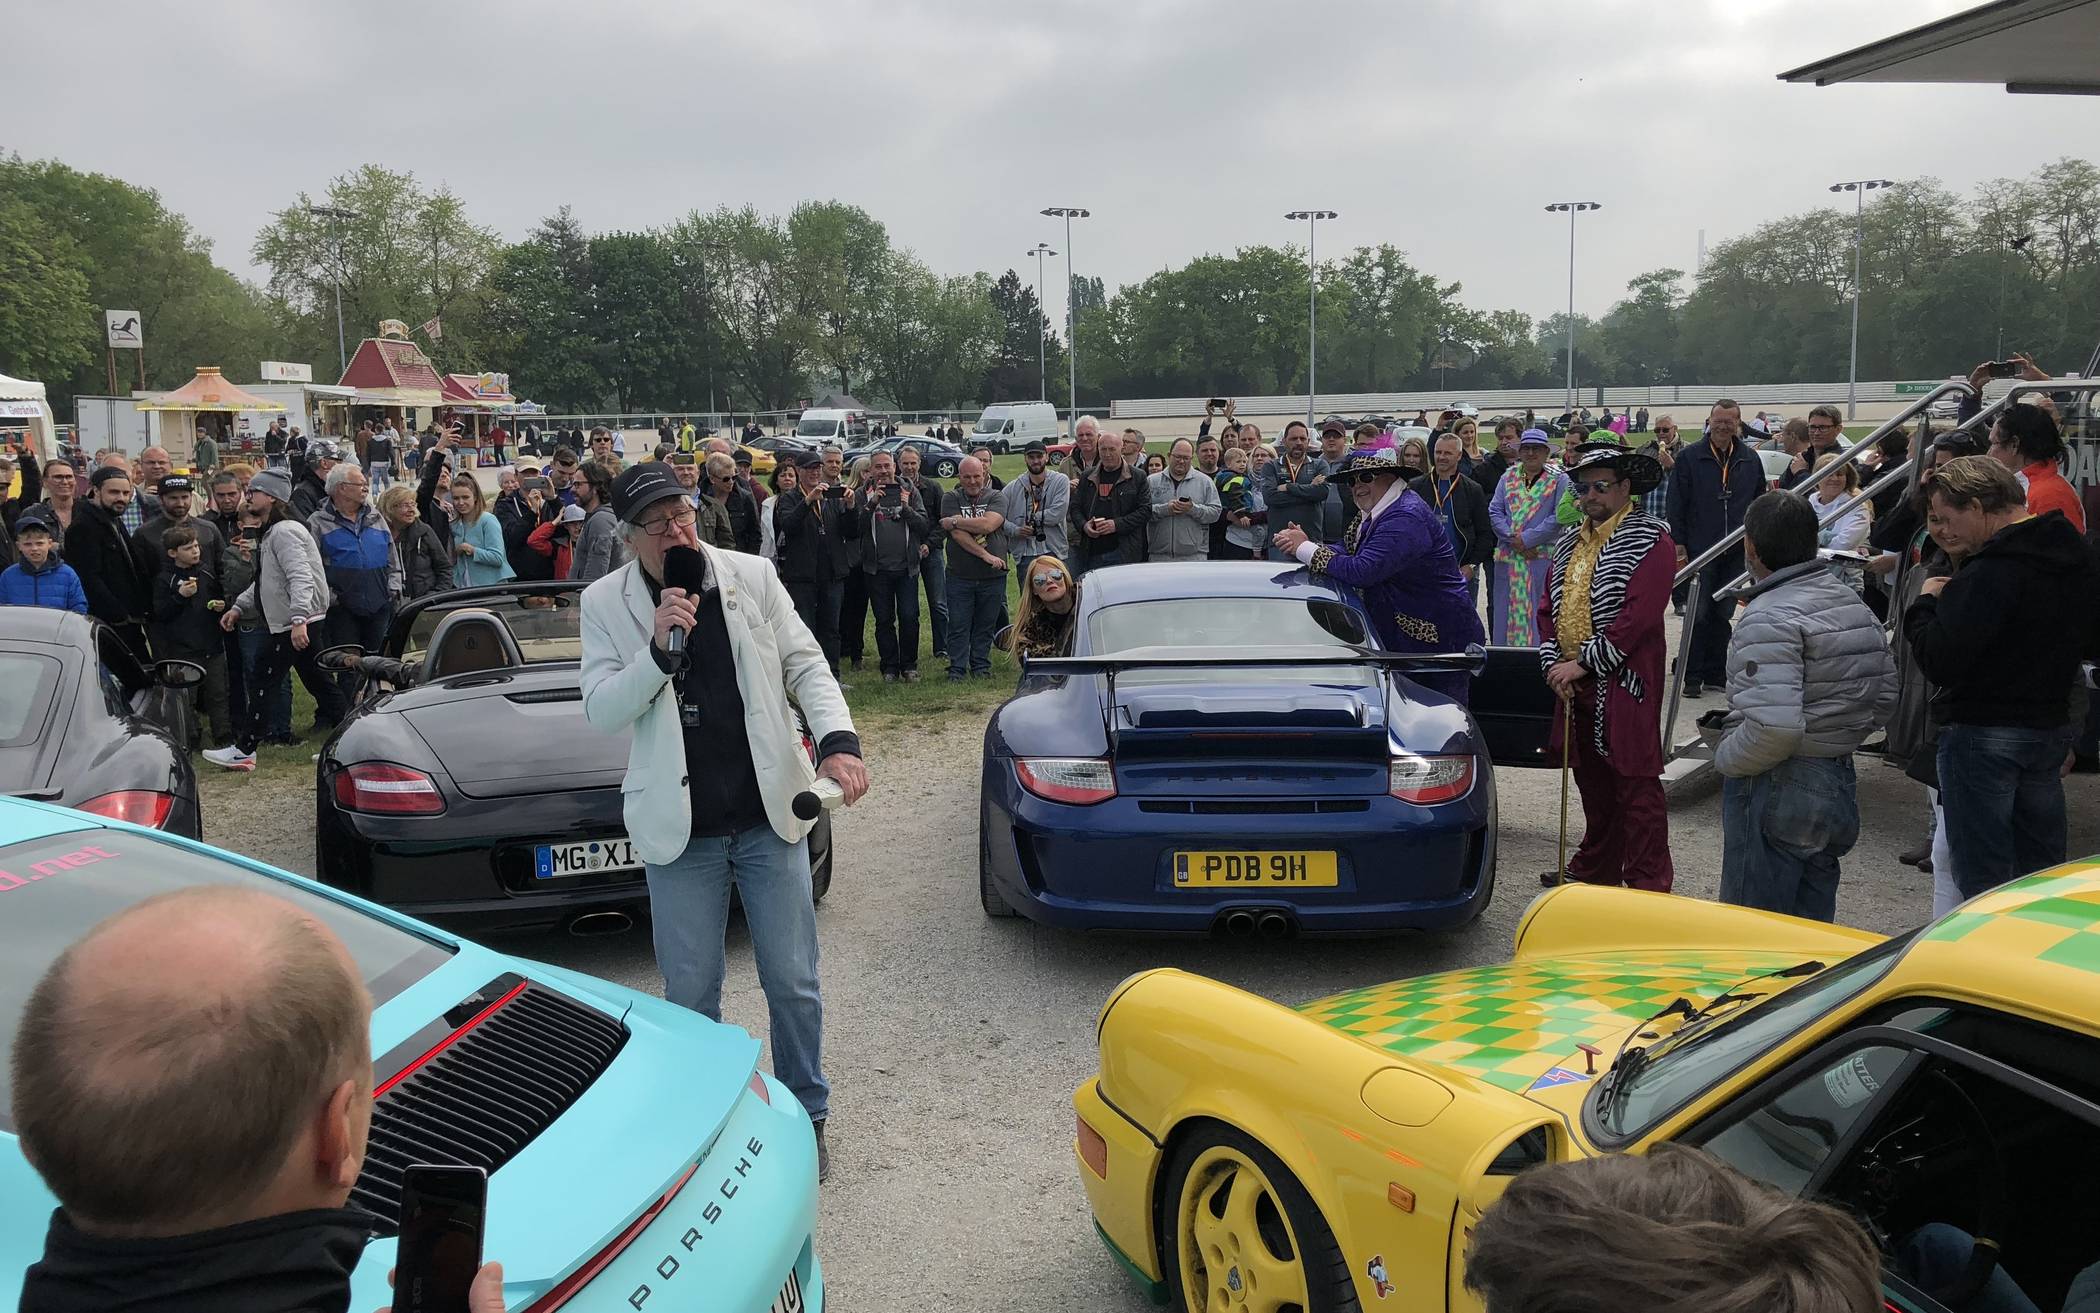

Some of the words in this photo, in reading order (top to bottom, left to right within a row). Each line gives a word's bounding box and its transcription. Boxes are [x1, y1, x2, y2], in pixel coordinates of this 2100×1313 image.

[552, 846, 586, 873] MG
[1178, 871, 1188, 880] GB
[1205, 855, 1261, 881] PDB
[1270, 855, 1307, 881] 9H
[628, 1136, 763, 1312] PORSCHE
